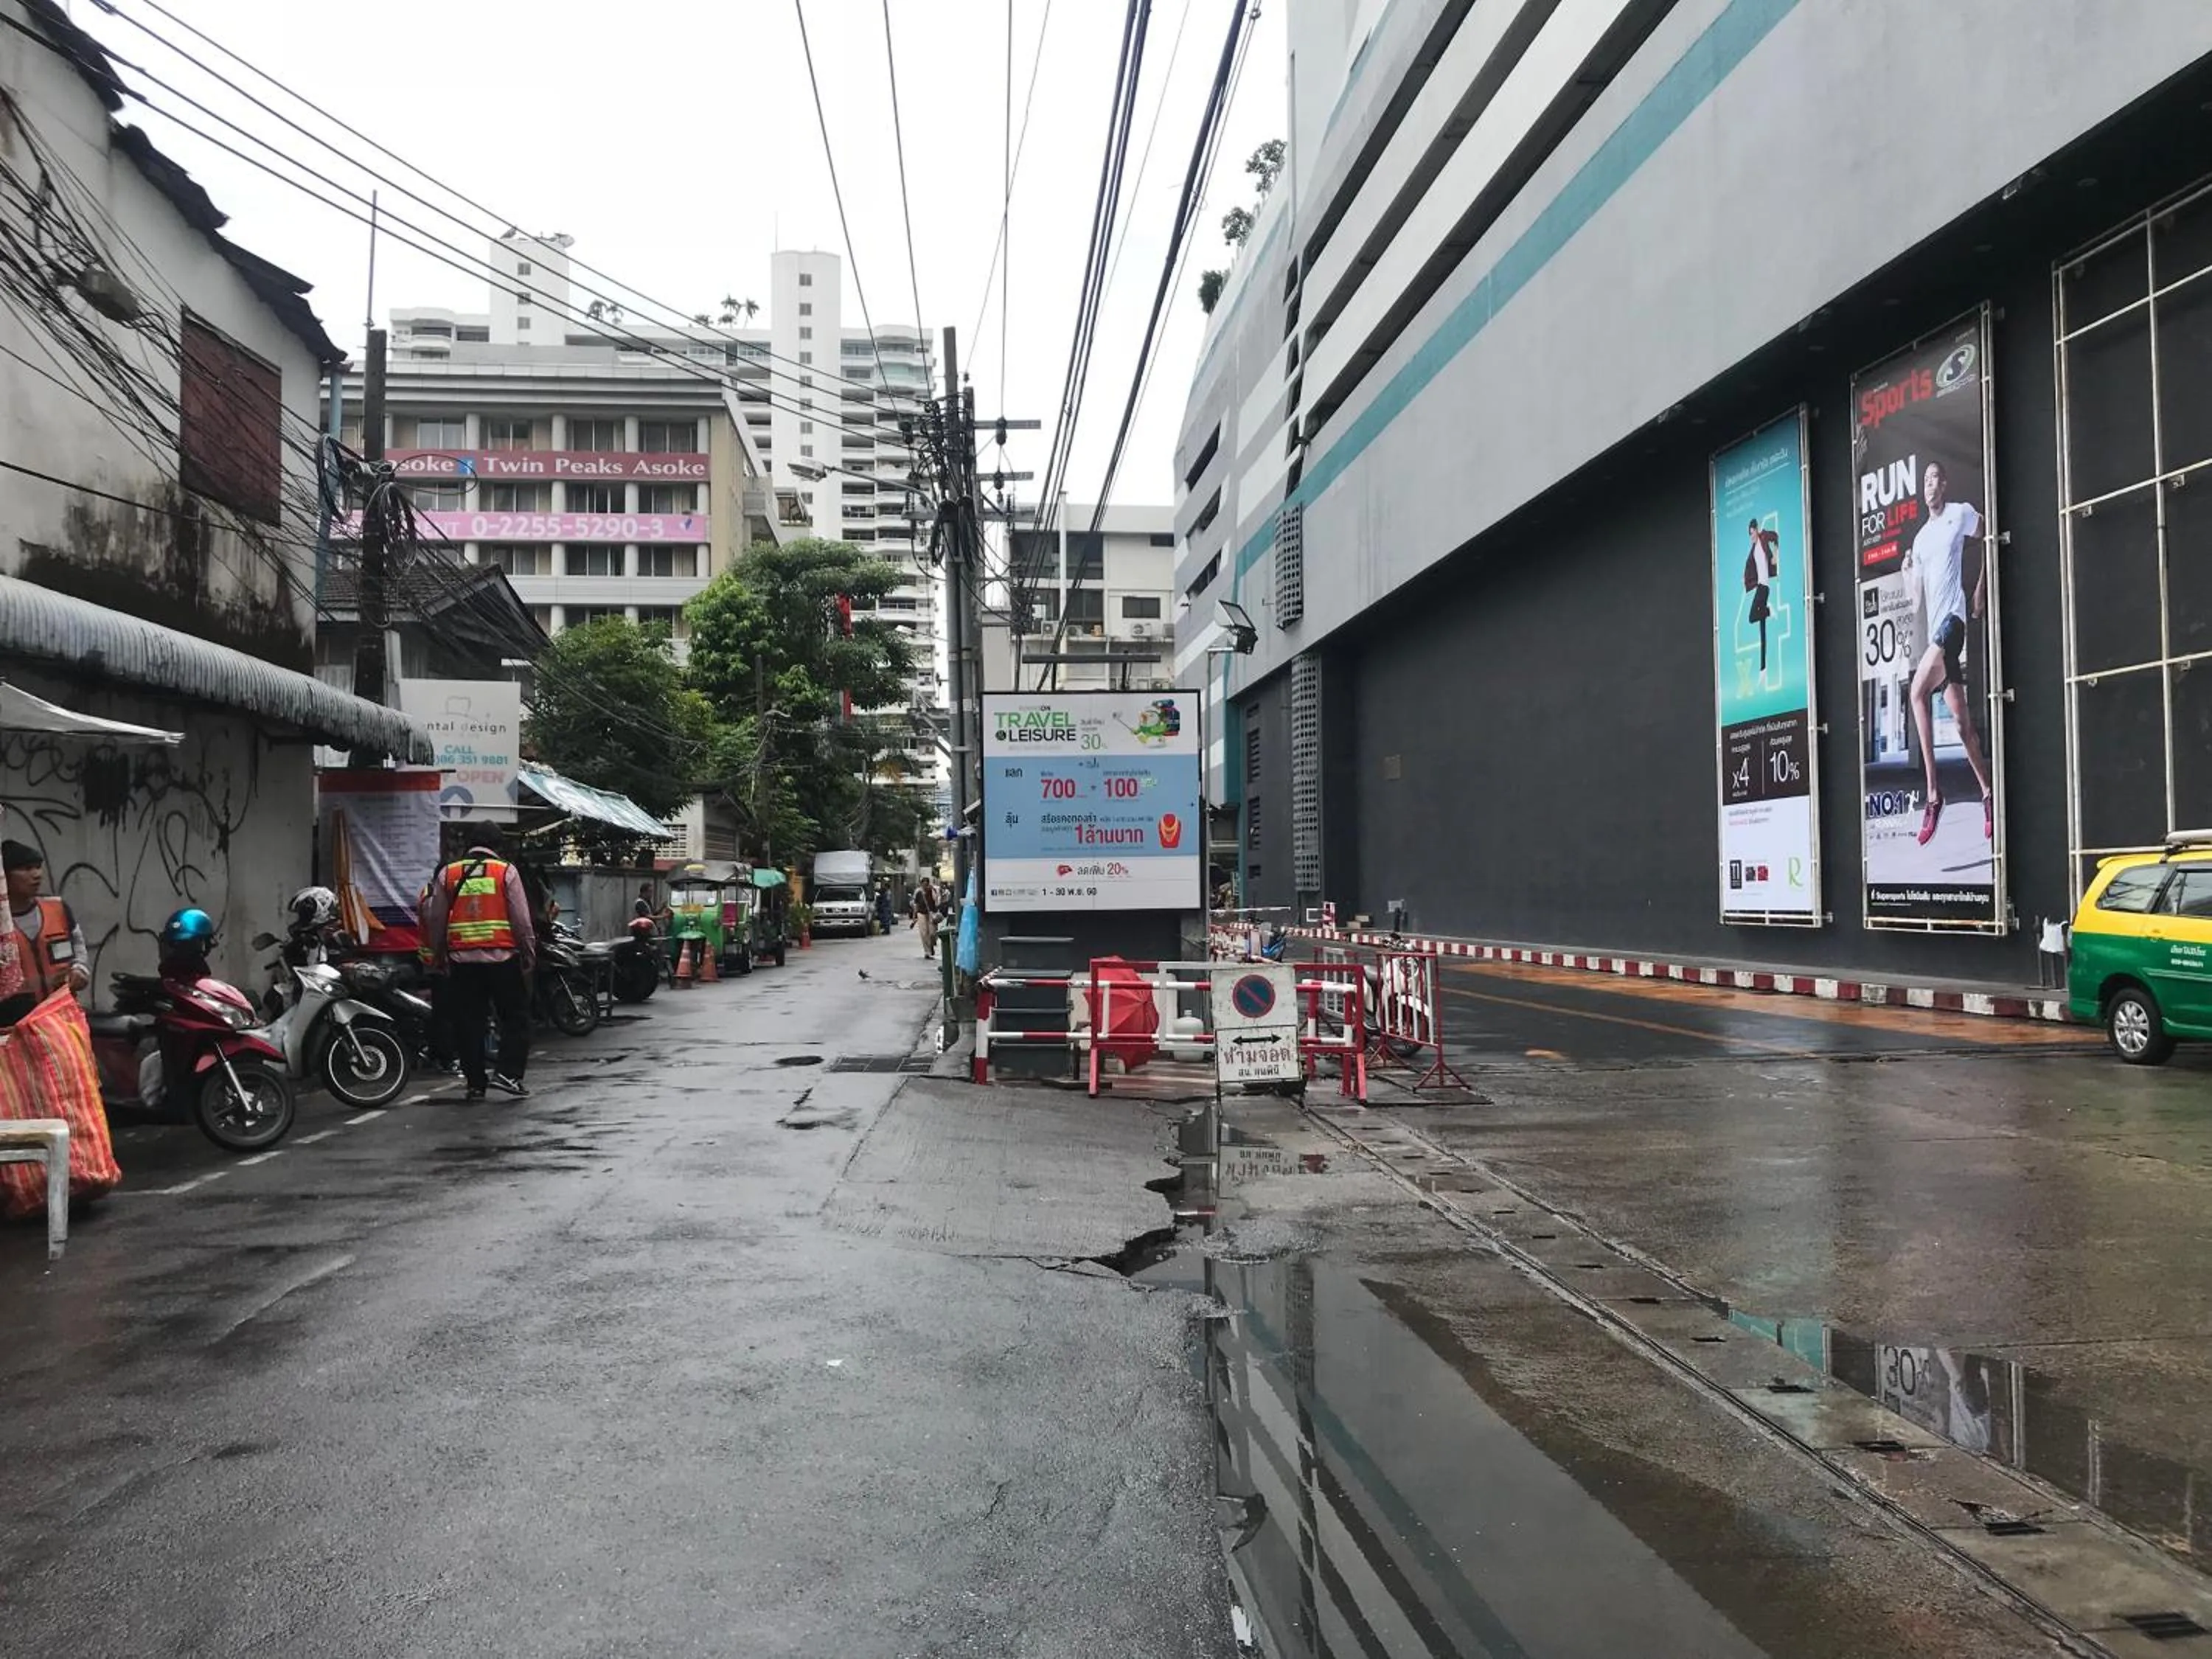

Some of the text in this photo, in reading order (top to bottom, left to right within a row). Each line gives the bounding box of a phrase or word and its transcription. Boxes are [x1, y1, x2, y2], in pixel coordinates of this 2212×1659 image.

[1861, 369, 1932, 428] Sports
[484, 457, 705, 475] Twin Peaks Asoke
[1861, 454, 1916, 514] RUN
[471, 515, 664, 538] 0-2255-5290-3
[1862, 501, 1919, 538] FOR LIFE
[425, 721, 507, 735] ntal design
[994, 712, 1077, 728] TRAVEL
[1009, 728, 1077, 742] LEISURE
[444, 744, 475, 754] CALL
[456, 770, 504, 784] OPEN
[1040, 779, 1076, 799] 700
[1104, 778, 1138, 798] 100
[1223, 1046, 1291, 1065] ห้ามจอด
